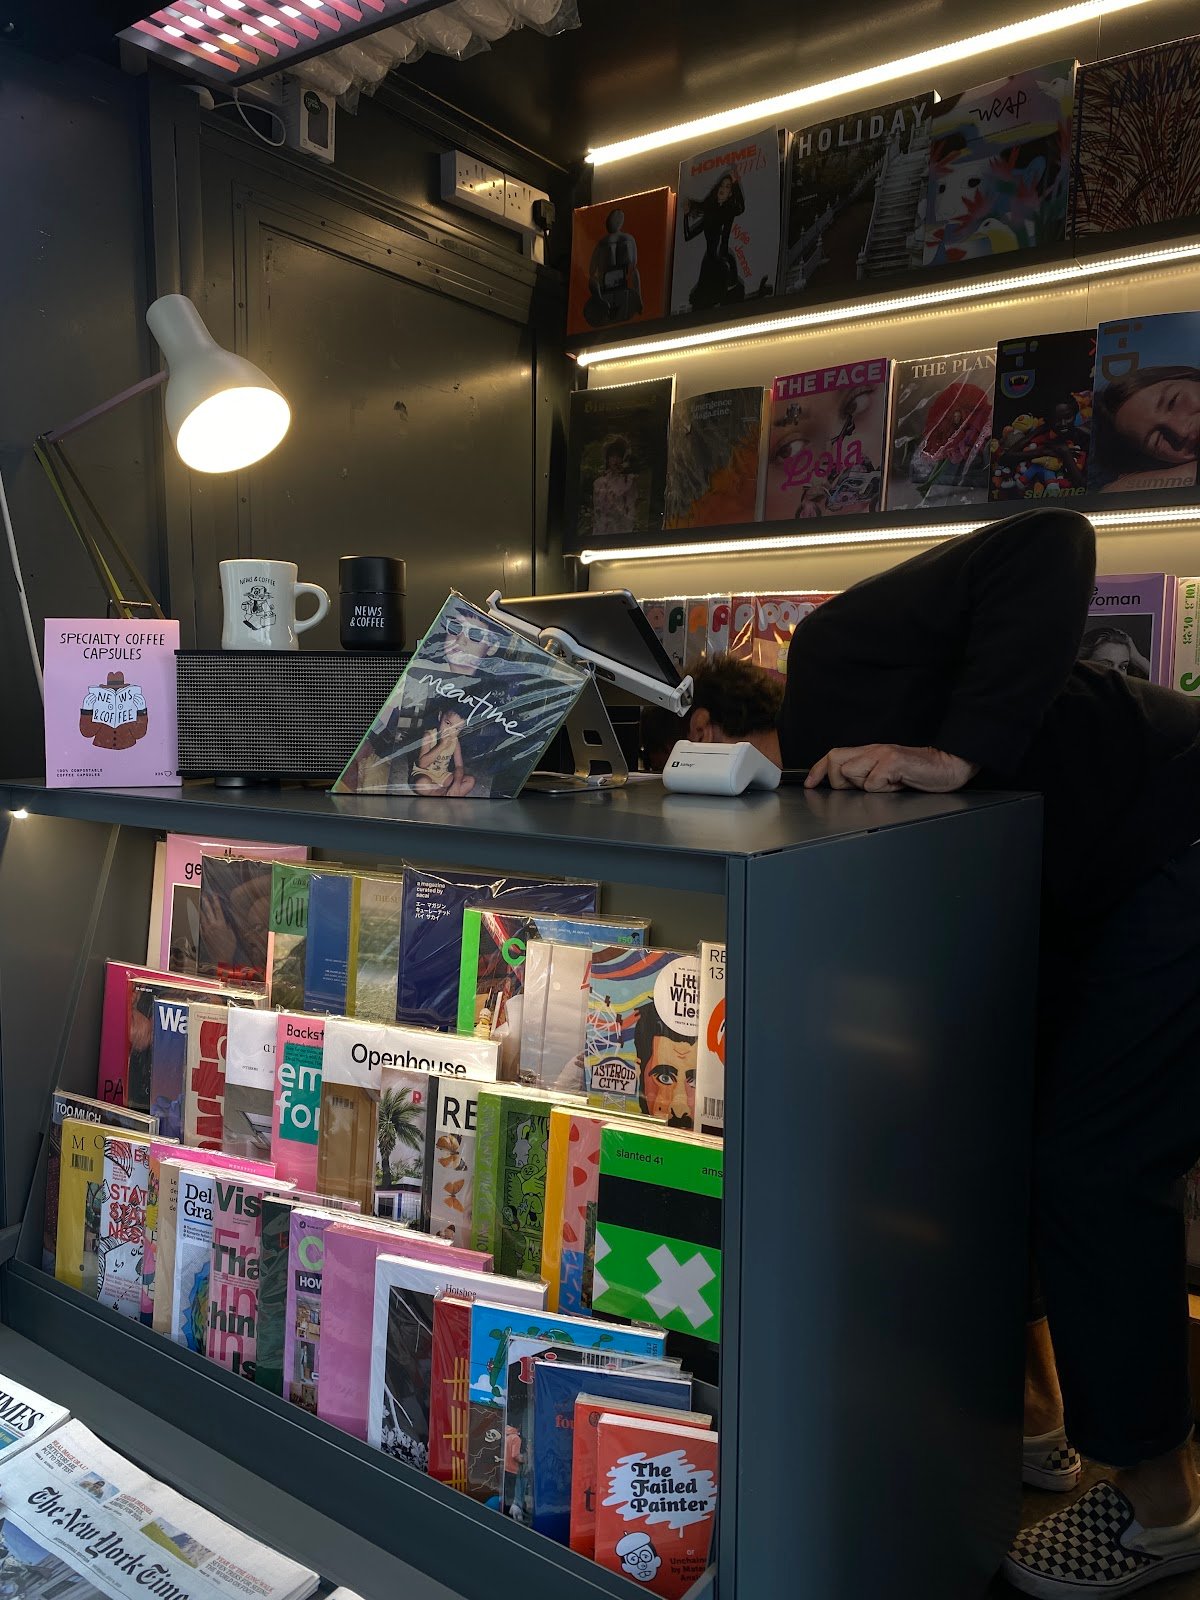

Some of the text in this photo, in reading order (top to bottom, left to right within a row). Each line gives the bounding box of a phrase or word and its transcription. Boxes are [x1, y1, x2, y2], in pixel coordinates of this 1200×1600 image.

[969, 90, 1027, 121] WRAP
[798, 102, 928, 159] HOLIDAY
[690, 144, 757, 176] HOMME
[912, 361, 947, 380] THE
[776, 362, 882, 398] THE FACE
[1127, 476, 1194, 489] summe
[239, 576, 253, 586] NEWS
[258, 577, 276, 587] COFFEE
[354, 606, 382, 617] NEWS
[349, 617, 385, 628] &COFFEE
[59, 633, 166, 646] SPECIALTY COFFEE
[83, 648, 142, 660] CAPSULES
[418, 672, 527, 739] meantime
[421, 881, 446, 889] magazine
[286, 1024, 325, 1040] Backst
[351, 1043, 467, 1078] Openhouse
[594, 1063, 636, 1082] ASTEROID
[598, 1077, 630, 1091] CITY
[55, 1101, 102, 1124] TOO MUCH
[616, 1148, 664, 1166] slanted 41
[702, 1166, 723, 1178] ams
[185, 1183, 213, 1204] Del
[184, 1200, 214, 1221] Gra
[445, 1283, 477, 1298] Hotshoe
[41, 1447, 51, 1458] PUT
[61, 1464, 74, 1475] TEST
[630, 1462, 673, 1478] The
[630, 1478, 698, 1497] Failed
[630, 1497, 709, 1513] Painter
[27, 1486, 65, 1518] The
[52, 1507, 101, 1541] New
[84, 1531, 147, 1576] York
[204, 1563, 216, 1574] THE
